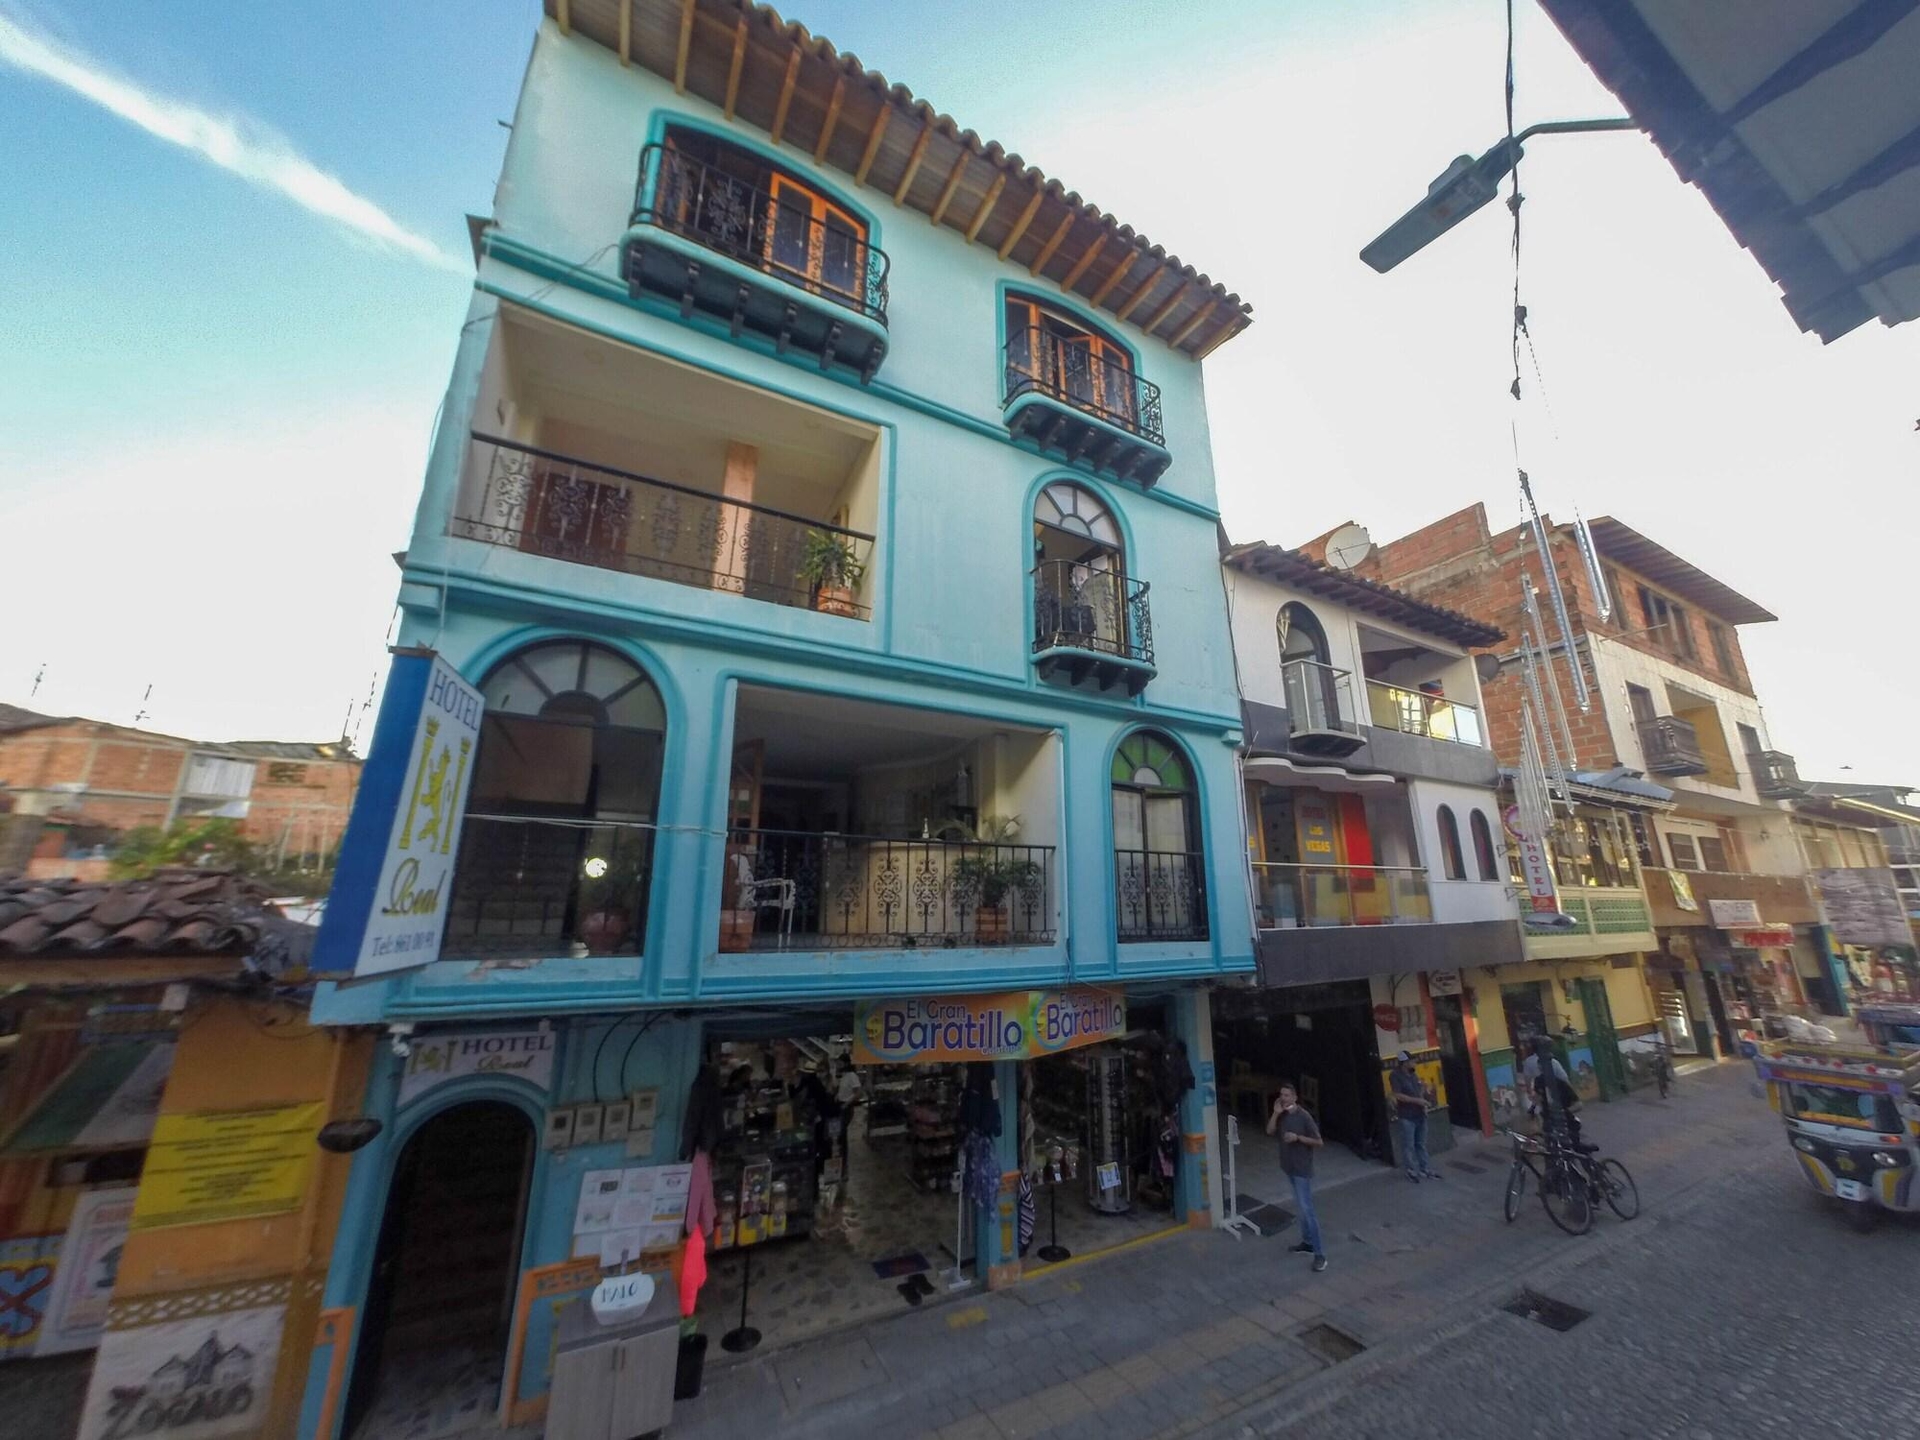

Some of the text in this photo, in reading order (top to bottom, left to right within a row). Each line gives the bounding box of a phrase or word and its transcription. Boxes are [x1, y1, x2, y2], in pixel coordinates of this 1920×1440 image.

[429, 667, 479, 731] HOTEL
[1526, 844, 1546, 896] HOTEL
[907, 1000, 966, 1019] El Gran
[1047, 997, 1123, 1040] Baratillo
[462, 1035, 552, 1055] HOTEL
[883, 1010, 1022, 1049] Baratillo
[475, 1054, 535, 1072] Real
